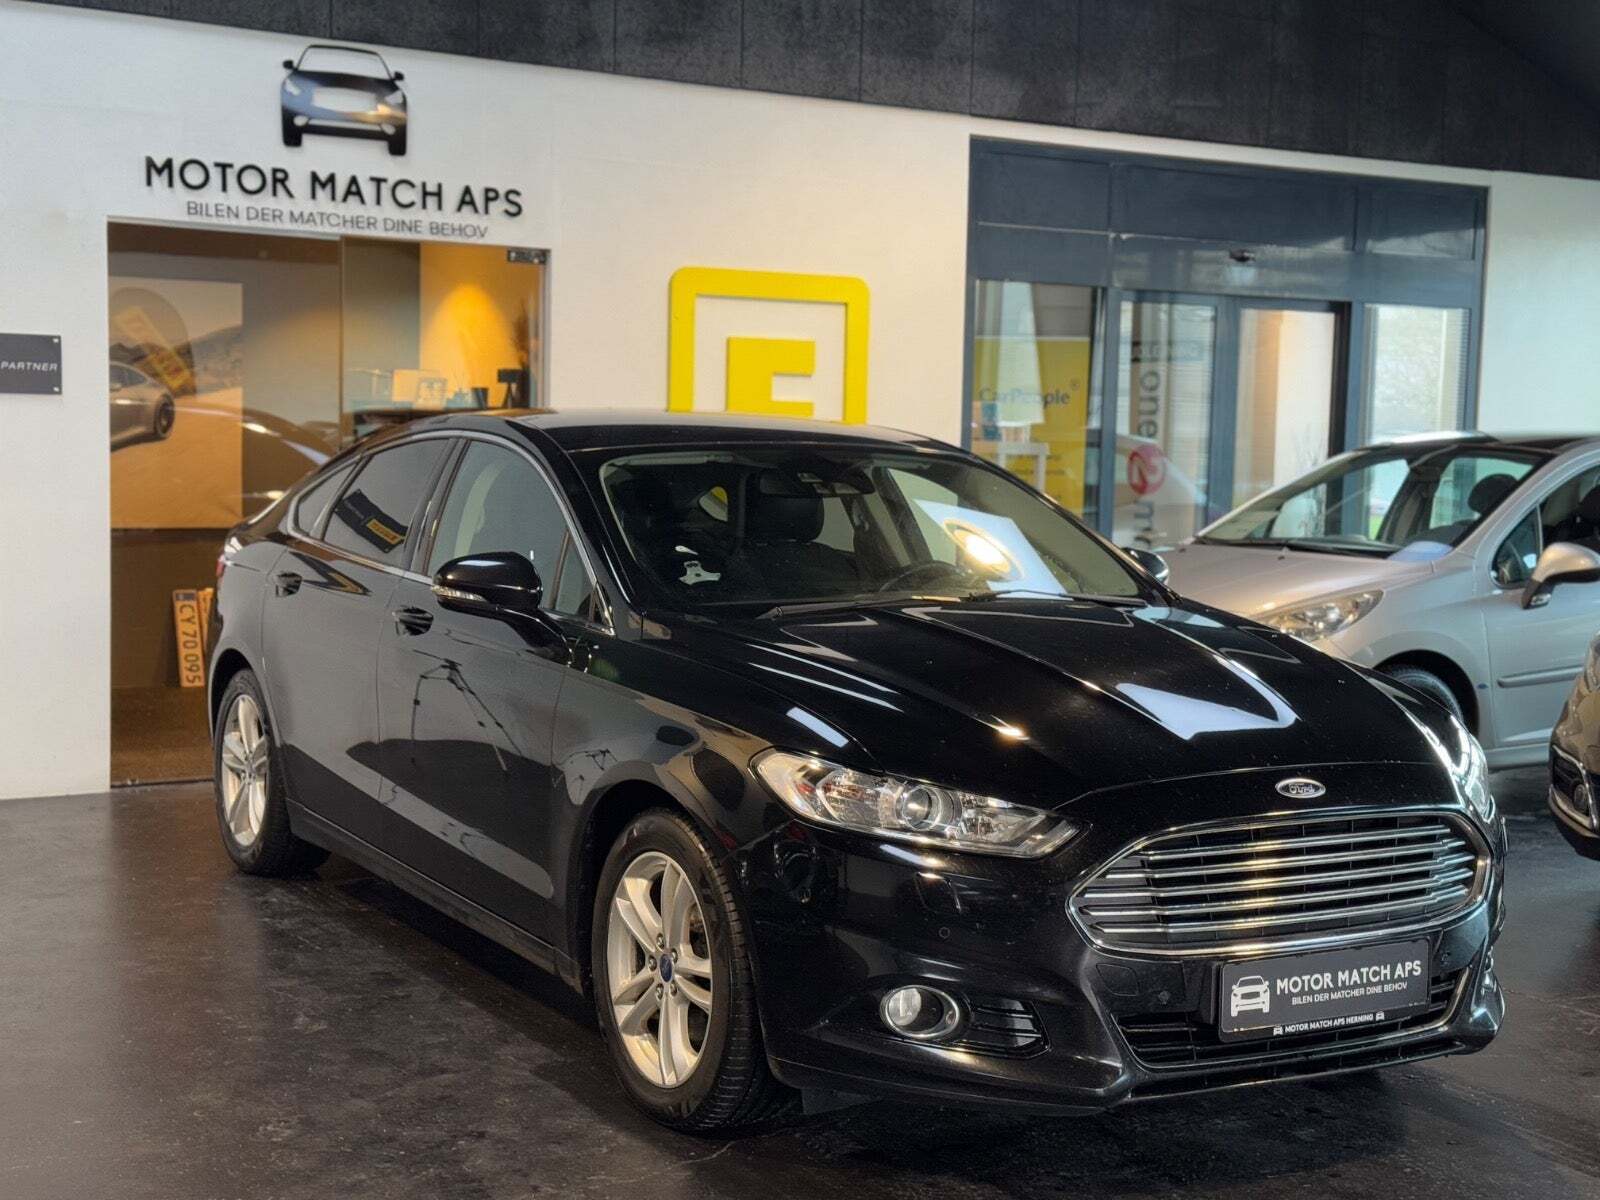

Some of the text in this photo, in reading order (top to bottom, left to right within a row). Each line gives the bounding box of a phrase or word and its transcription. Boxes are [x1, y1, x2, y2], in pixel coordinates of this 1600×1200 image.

[145, 156, 523, 217] MOTOR MATCH APS
[187, 201, 488, 238] BILEN DER MATCHER DINE BEHOV
[1, 361, 58, 371] PARTNER
[1276, 960, 1421, 995] MOTOR MATCH APS
[1292, 982, 1408, 1005] BILEN DER MATCHER DINE BEHOV
[1285, 1022, 1308, 1033] MOTOR
[1310, 1019, 1332, 1030] MATCH
[1334, 1017, 1345, 1026] APS
